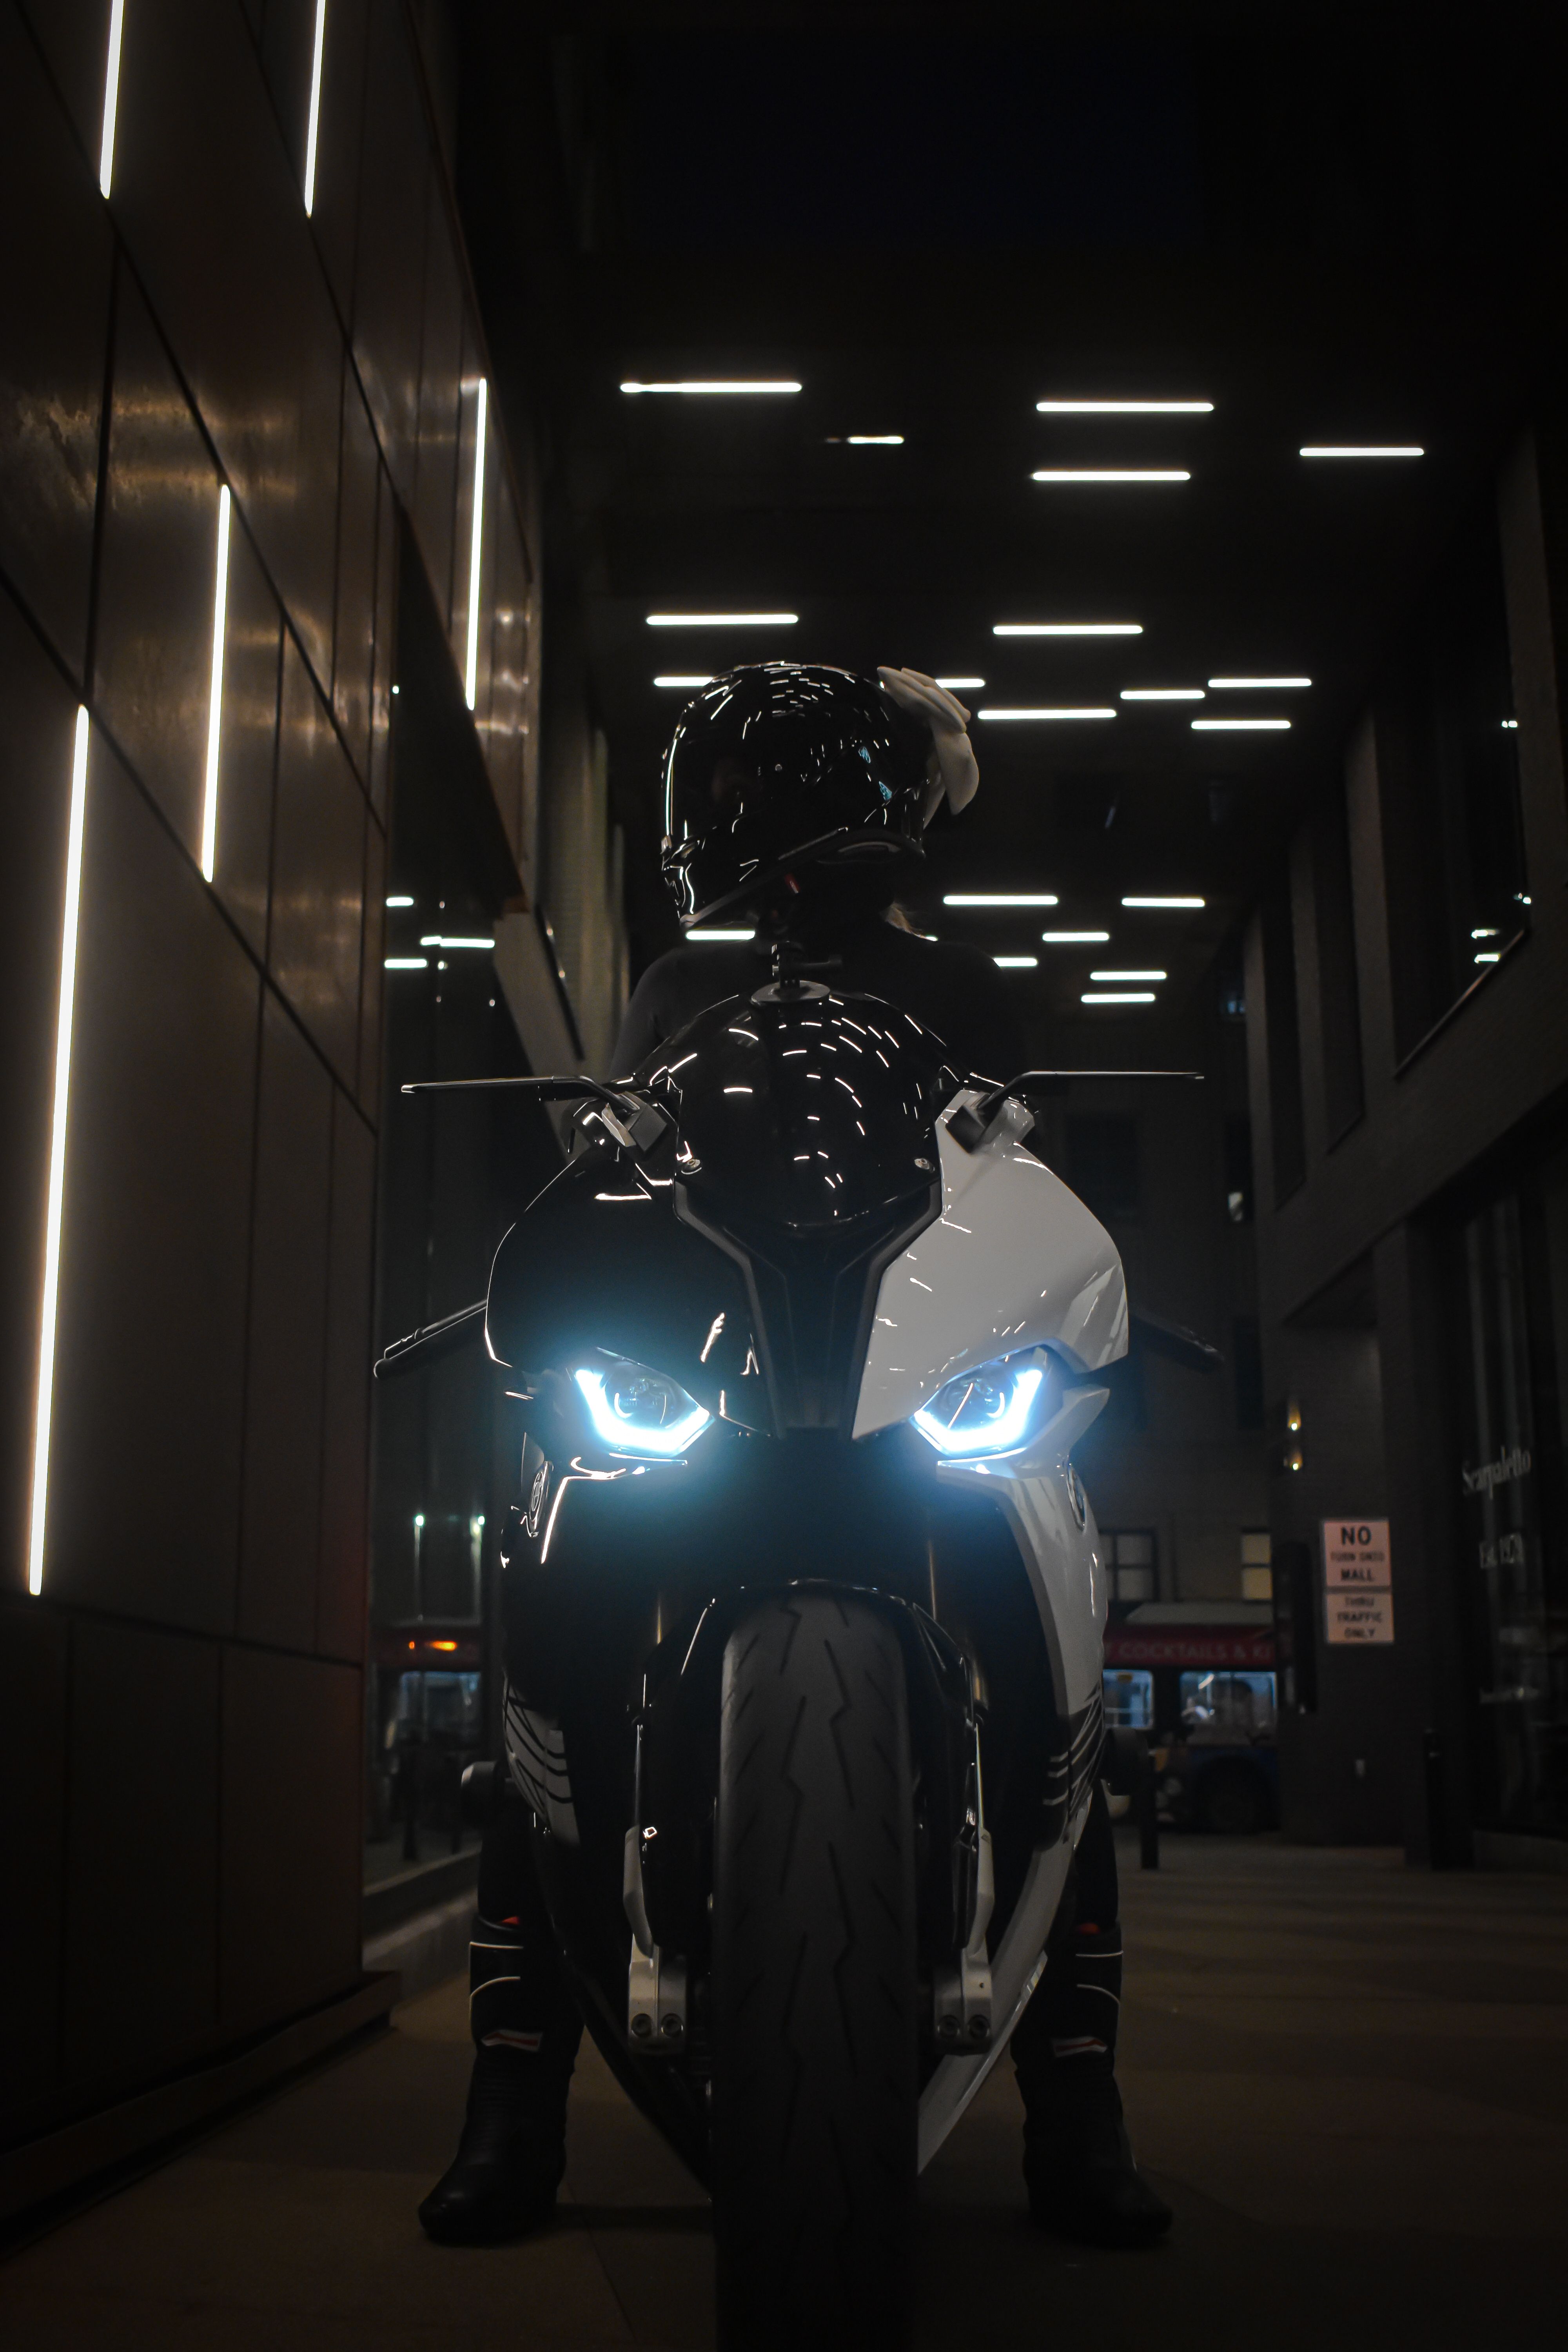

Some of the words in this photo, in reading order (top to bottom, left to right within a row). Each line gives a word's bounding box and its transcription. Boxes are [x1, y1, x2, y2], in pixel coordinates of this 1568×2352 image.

[1341, 1526, 1371, 1545] NO
[1341, 1568, 1374, 1581] MALL
[1337, 1612, 1382, 1624] TRAFFIC
[1344, 1627, 1375, 1639] ONLY
[1118, 1641, 1227, 1660] COCKTAILS
